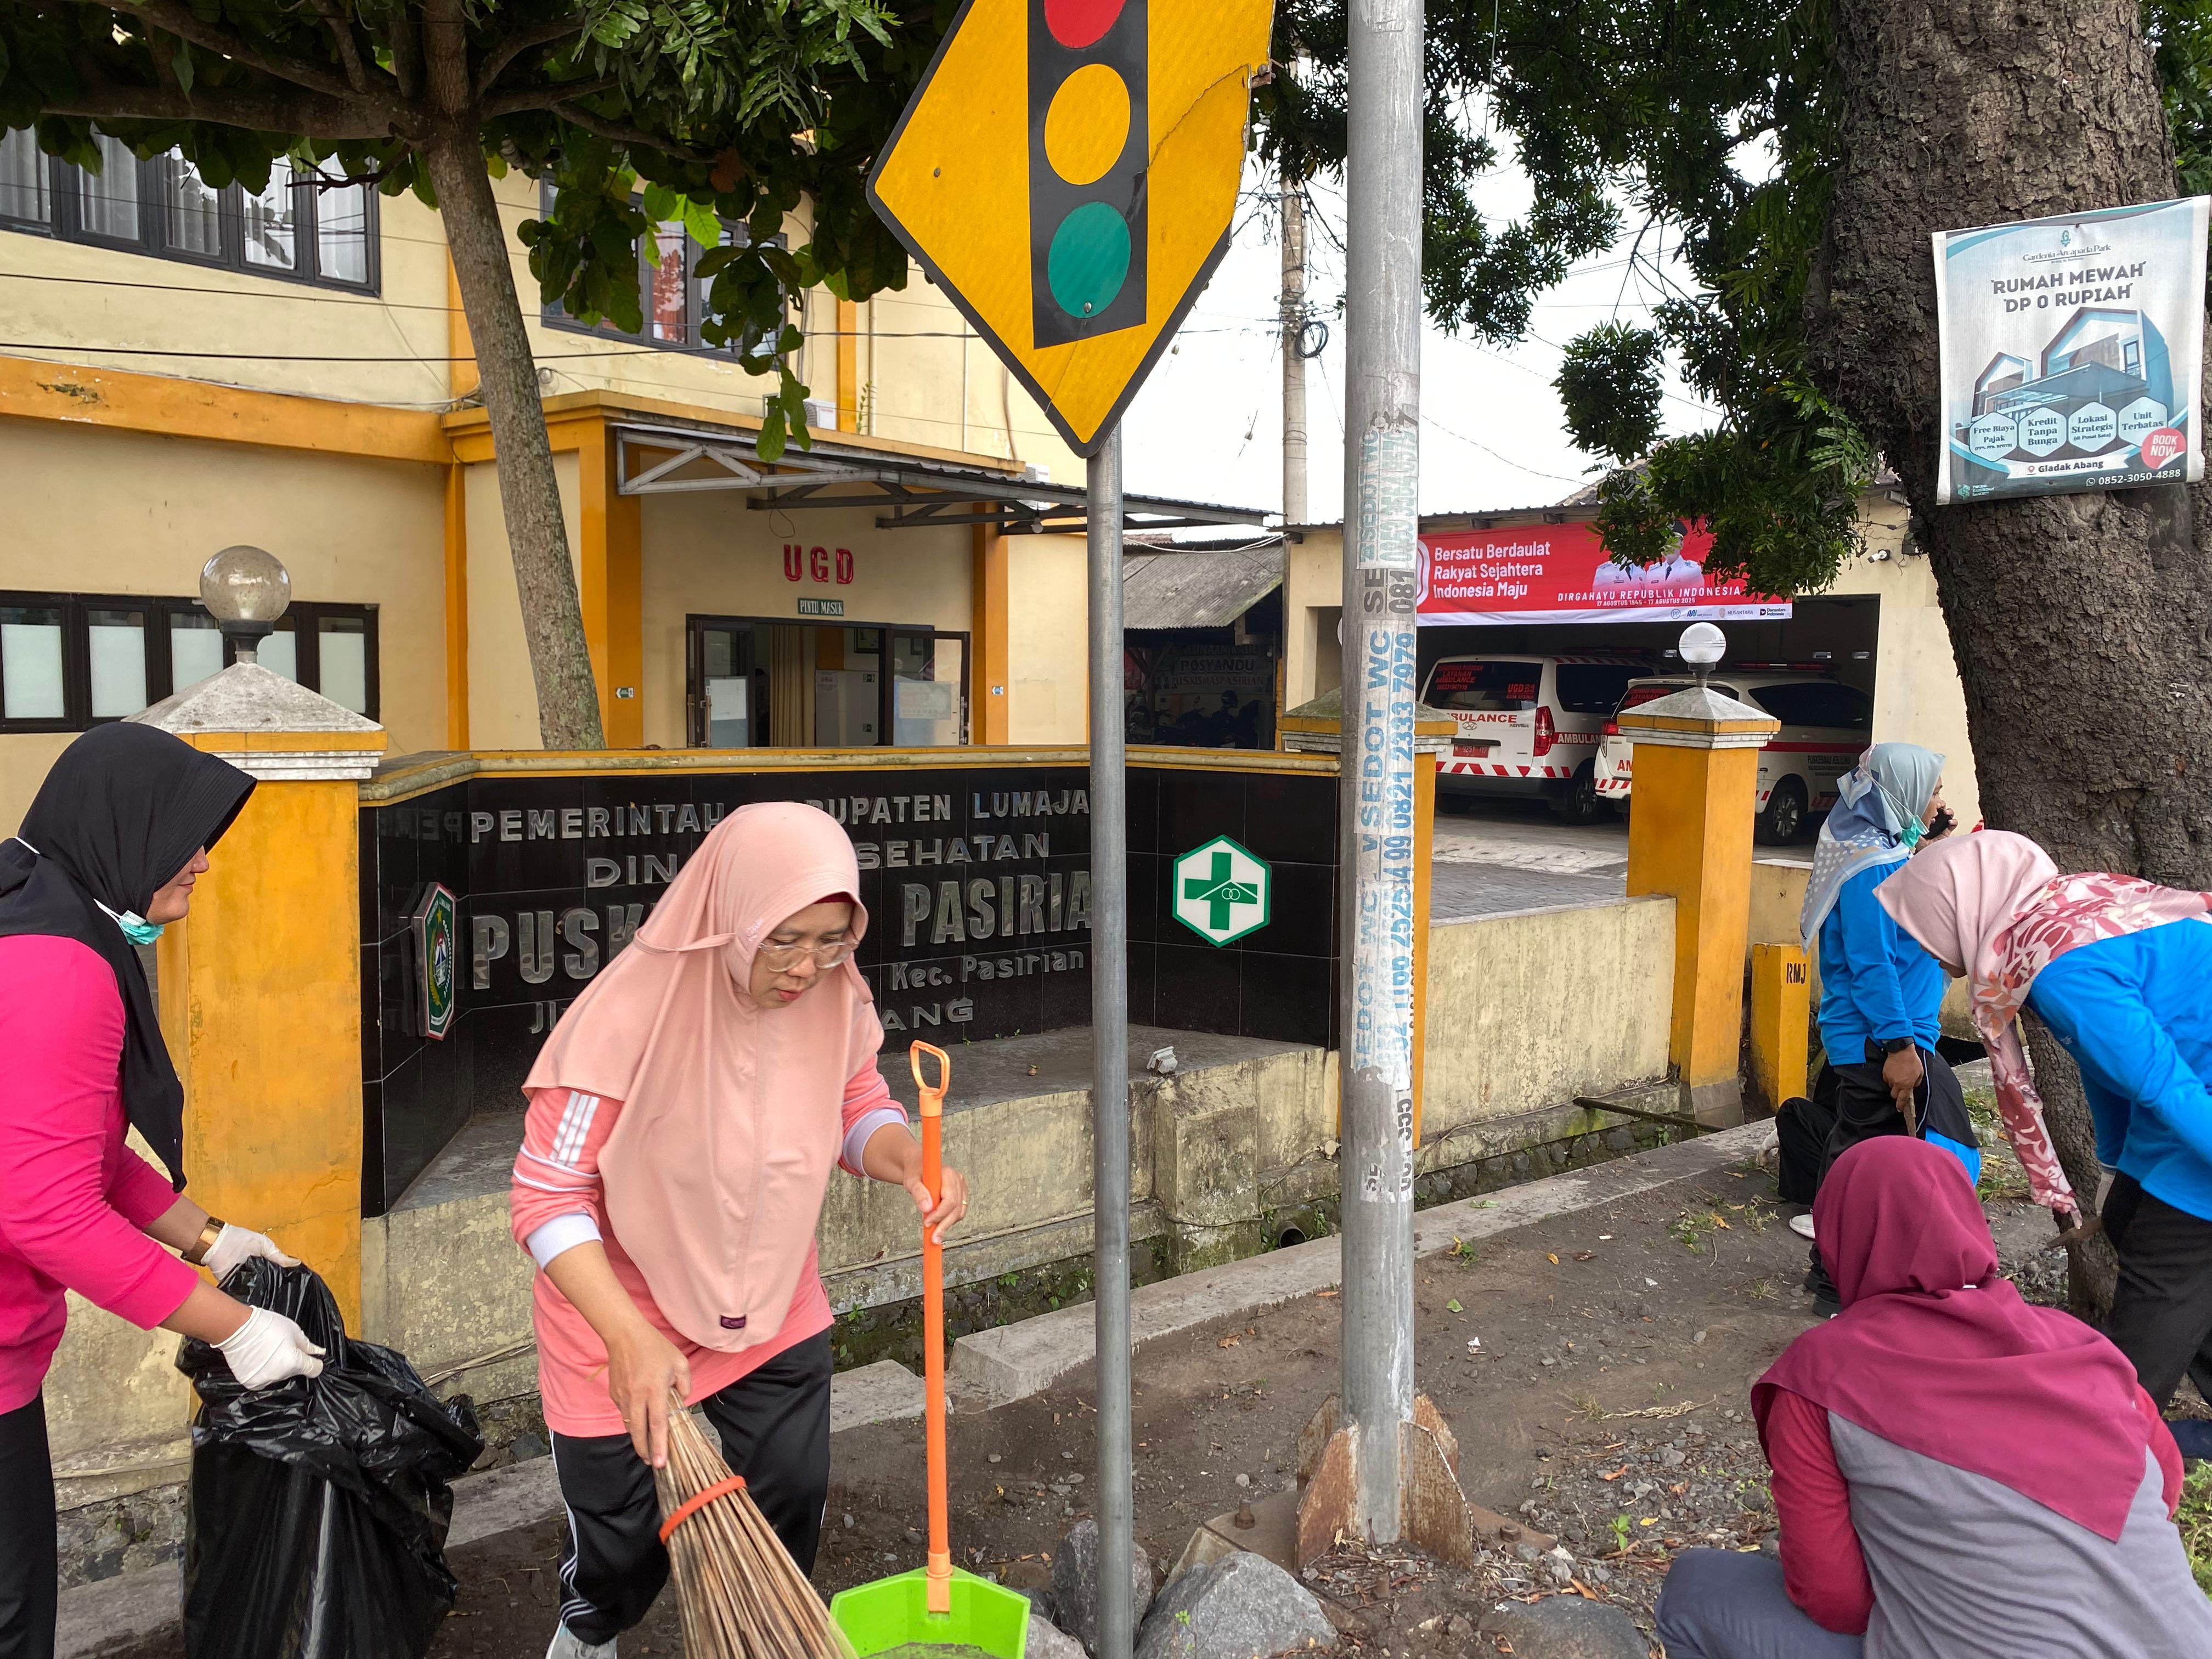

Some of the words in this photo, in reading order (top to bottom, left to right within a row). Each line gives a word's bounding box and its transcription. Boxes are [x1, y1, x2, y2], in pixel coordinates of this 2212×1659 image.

[1993, 273, 2063, 295] RUMAH
[2070, 262, 2144, 285] MEWAH
[2005, 297, 2032, 313] DP
[2056, 284, 2131, 307] RUPIAH
[2028, 417, 2058, 427] Kredit
[2078, 414, 2108, 424] Lokasi
[2134, 411, 2152, 420] Unit
[2028, 427, 2058, 437] Tanpa
[2071, 423, 2114, 434] Strategis
[2121, 421, 2164, 431] Terbatas
[1983, 435, 2005, 443] Pajak
[2028, 437, 2058, 446] Bunga
[2152, 435, 2178, 445] BOOK
[2150, 445, 2175, 457] NOW
[2038, 462, 2072, 473] Gladak
[2073, 461, 2104, 470] Abang
[2098, 469, 2181, 486] 0852-3050-4888
[1359, 471, 1378, 541] SEDOT
[1435, 546, 1483, 561] Bersatu
[1486, 540, 1550, 559] Berdaulat
[783, 544, 854, 584] UGD
[1434, 565, 1477, 583] Rakyat
[1480, 562, 1543, 582] Sejahtera
[1433, 582, 1494, 599] Indonesia
[1497, 580, 1528, 600] Maju
[1558, 591, 1615, 602] DIRGAHAYU
[1620, 589, 1674, 600] REPUBLIK
[1679, 585, 1741, 598] INDONESIA
[800, 600, 819, 613] PINTU
[821, 601, 843, 614] MASUK
[1180, 658, 1255, 673] POSYANDU
[1367, 630, 1391, 689] WC
[1392, 632, 1416, 693] 7979
[1508, 684, 1523, 692] UGD
[1449, 713, 1517, 723] BULANCE
[1389, 701, 1414, 763] 2333
[1361, 702, 1386, 826] SEDOT
[1386, 772, 1413, 829] 0821
[471, 802, 725, 843] PEMERINTAH
[802, 793, 951, 825] UPATEN
[891, 962, 953, 991] Kec.
[961, 950, 1084, 983] Pasirian
[1786, 962, 1806, 984] RMJ
